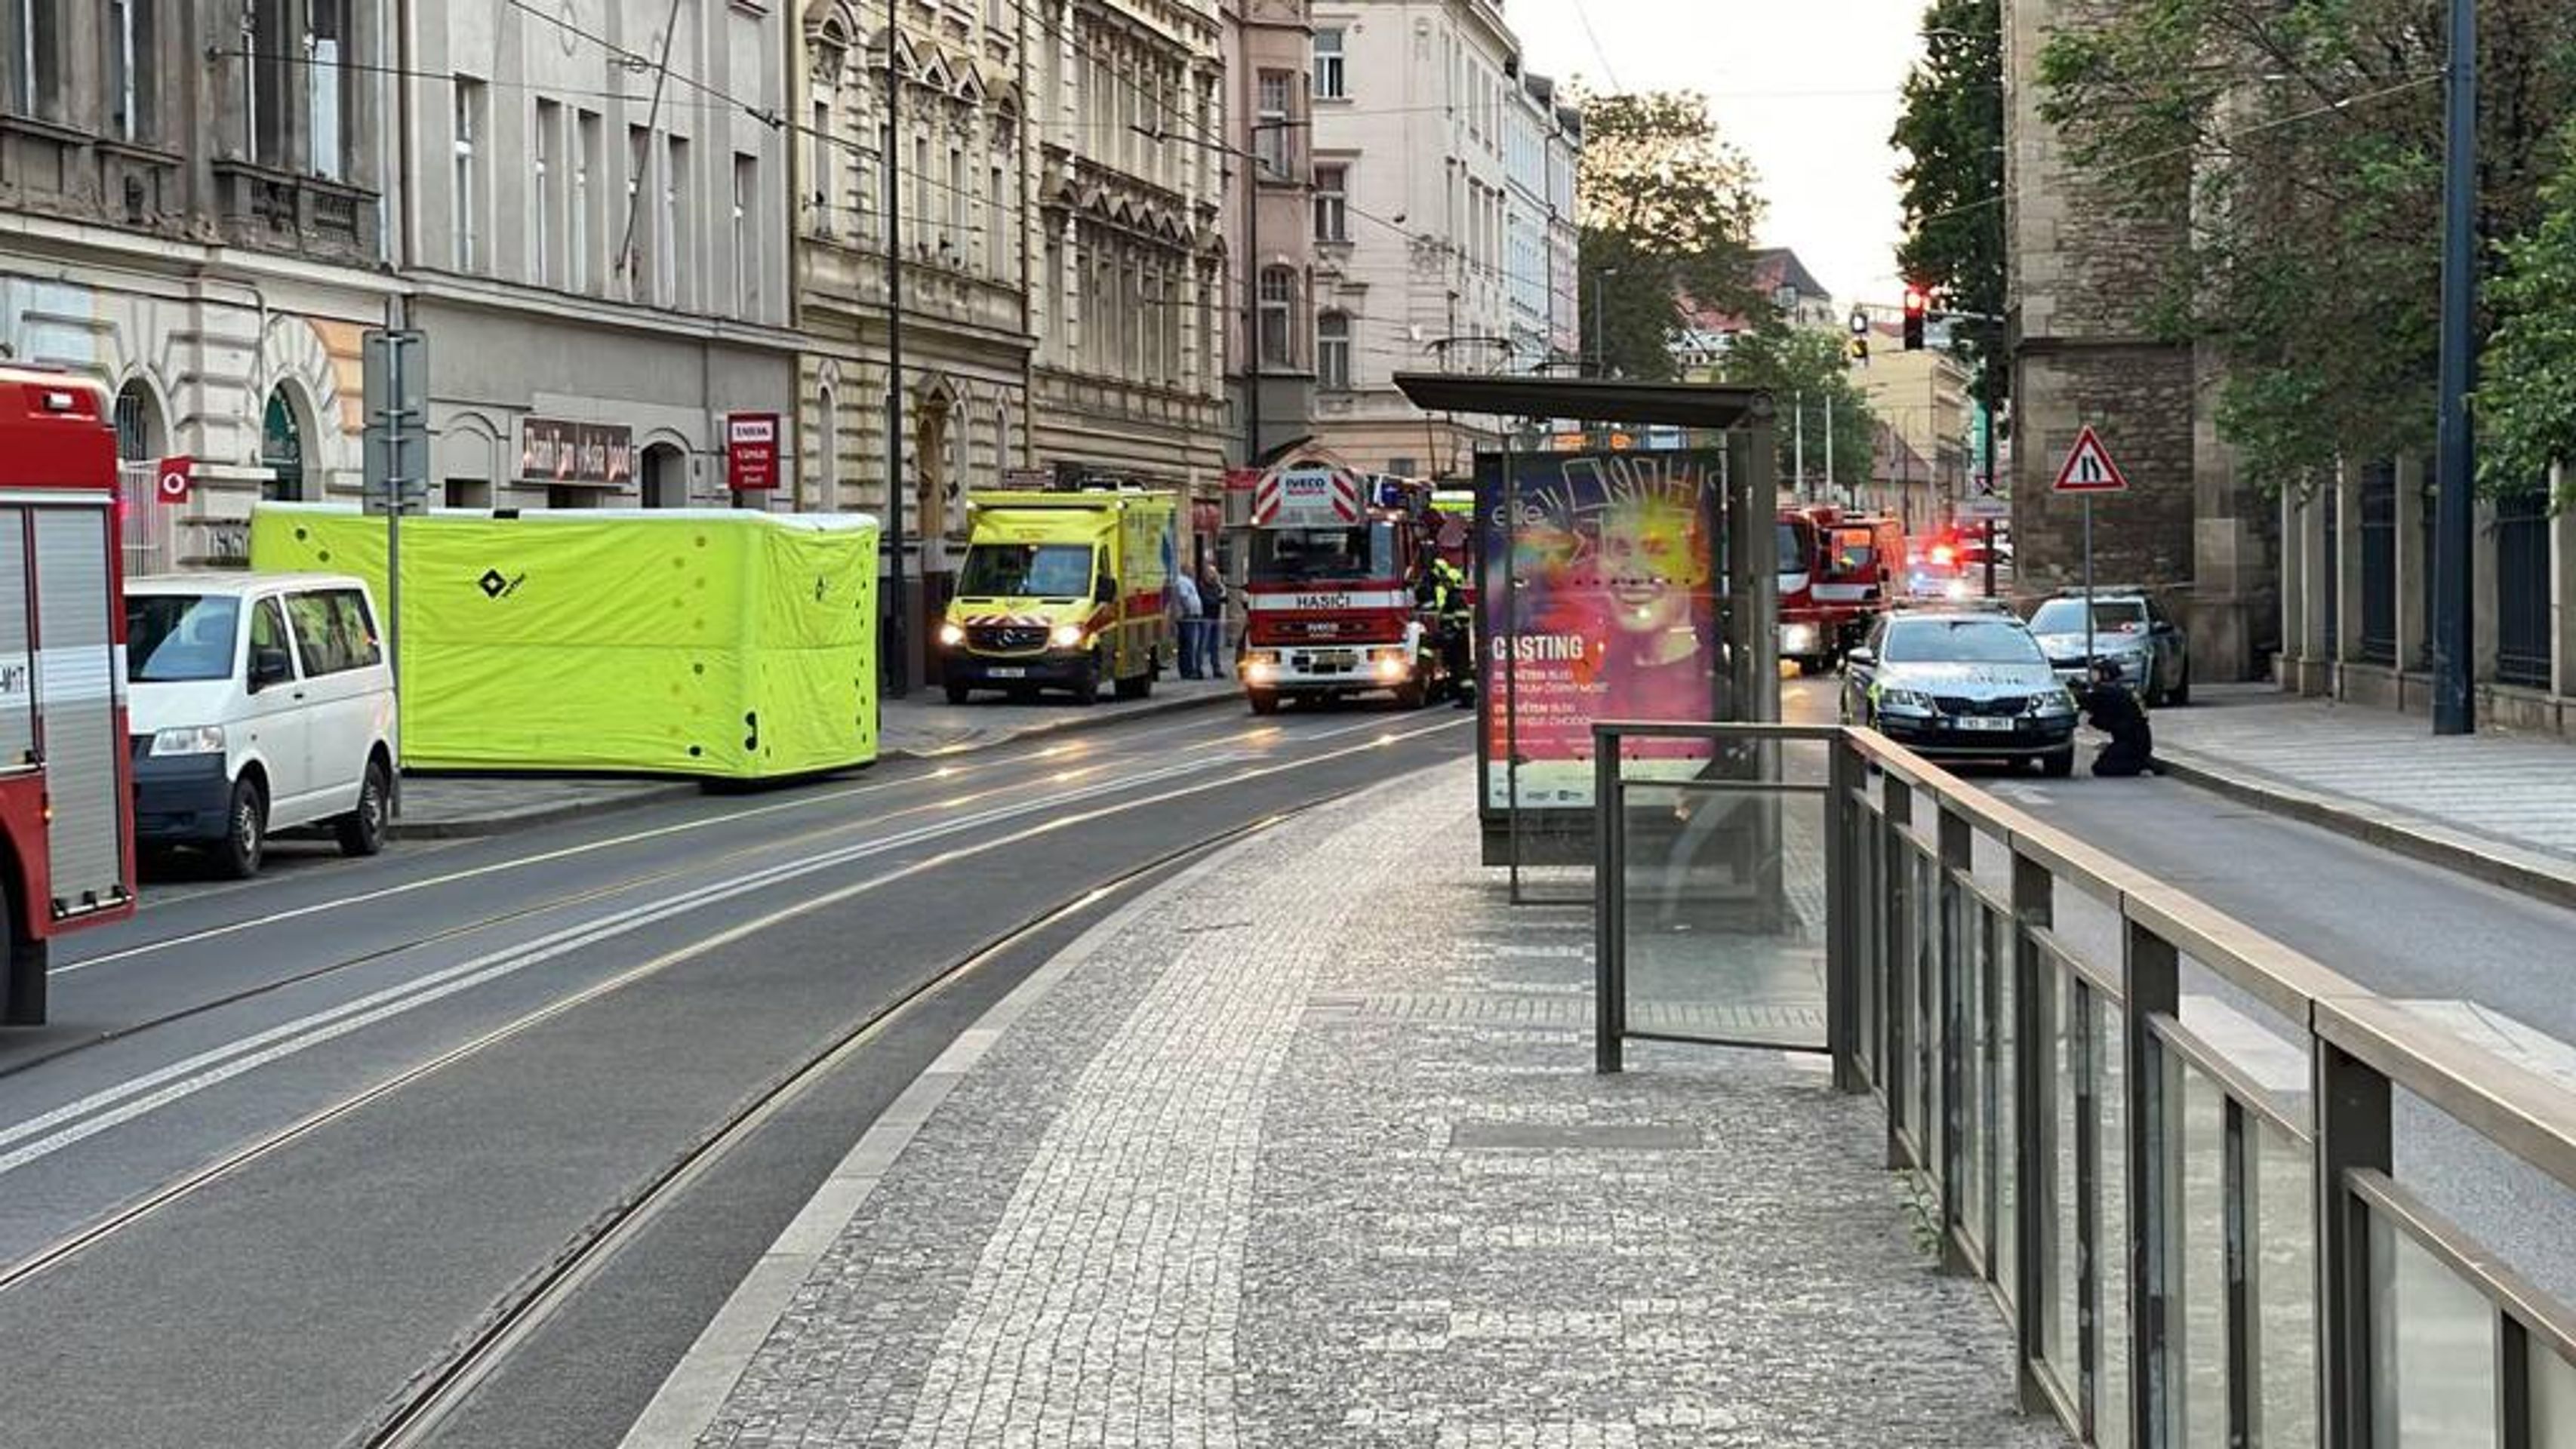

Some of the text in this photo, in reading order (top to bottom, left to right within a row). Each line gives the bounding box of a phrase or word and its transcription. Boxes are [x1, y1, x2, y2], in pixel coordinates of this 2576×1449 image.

[1286, 478, 1325, 488] IVECO
[1297, 592, 1350, 608] HASIČI
[1491, 635, 1584, 661] CASTING
